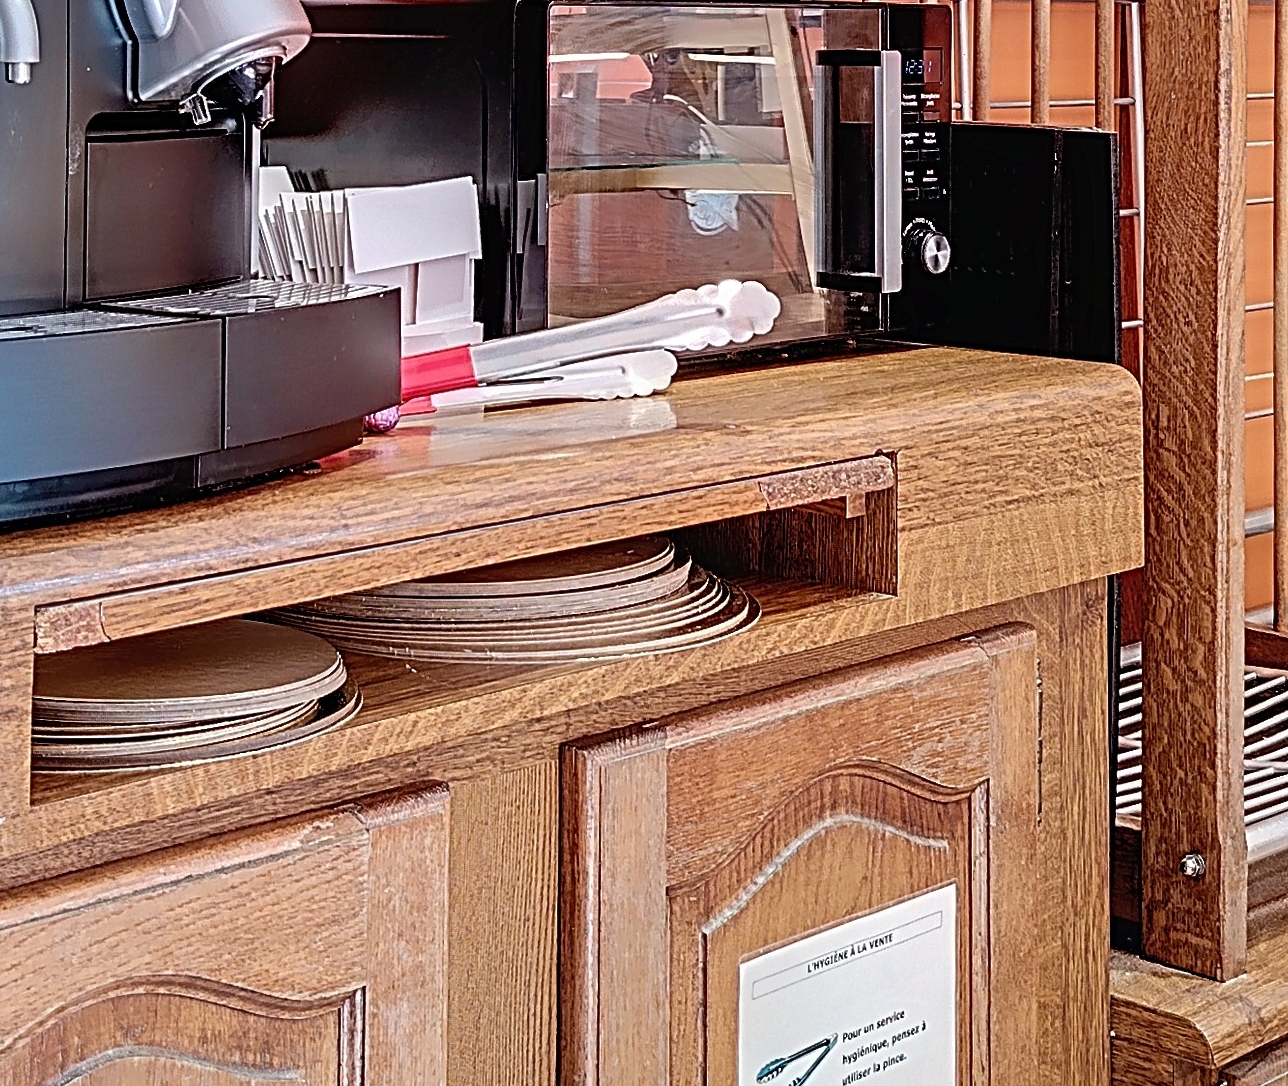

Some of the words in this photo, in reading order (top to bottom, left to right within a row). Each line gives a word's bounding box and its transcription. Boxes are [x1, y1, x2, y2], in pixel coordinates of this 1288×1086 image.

[807, 950, 848, 974] L'HYGIÈNE
[857, 943, 867, 954] LA
[869, 932, 893, 950] VENTE
[842, 1027, 862, 1043] Pour
[863, 1023, 874, 1034] un
[876, 1010, 905, 1030] service
[842, 1039, 890, 1065] hygiénique,
[891, 1025, 920, 1047] pensez
[842, 1066, 872, 1086] utiliser
[872, 1062, 881, 1074] la
[882, 1052, 908, 1072] pince.
